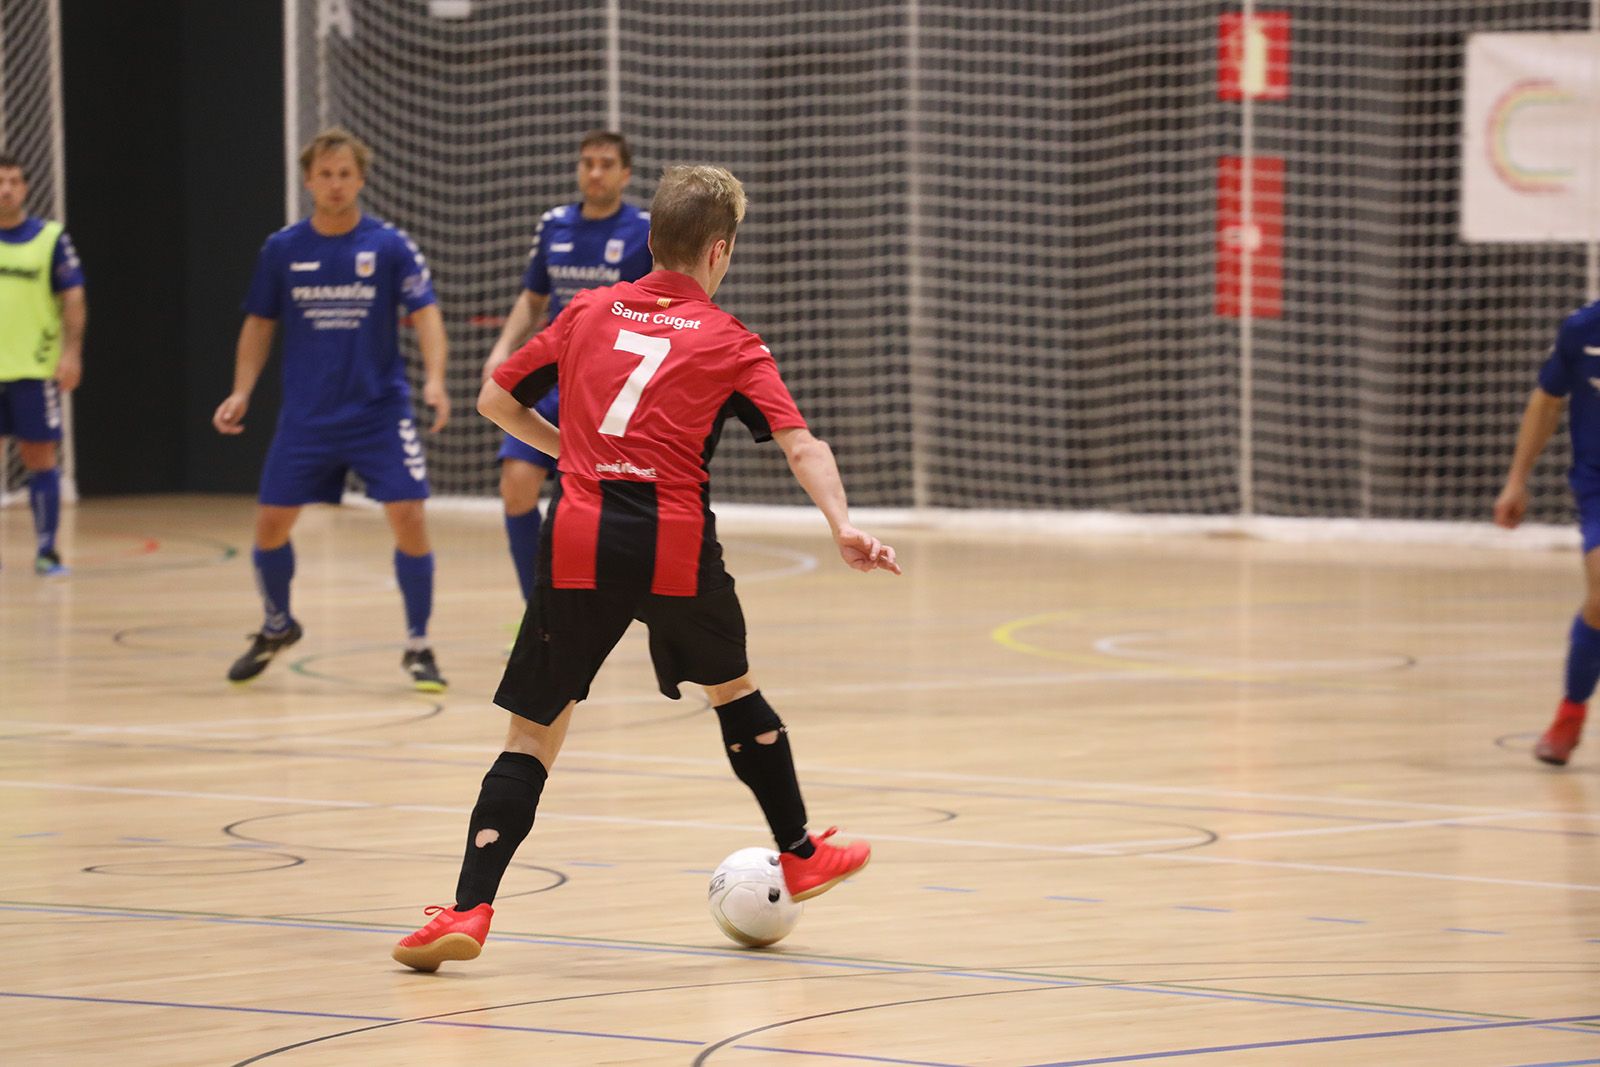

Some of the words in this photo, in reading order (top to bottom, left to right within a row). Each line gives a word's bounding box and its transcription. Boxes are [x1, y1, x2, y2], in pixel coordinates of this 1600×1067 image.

[611, 301, 650, 323] Sant
[653, 313, 701, 330] Cugat
[597, 328, 672, 437] 7
